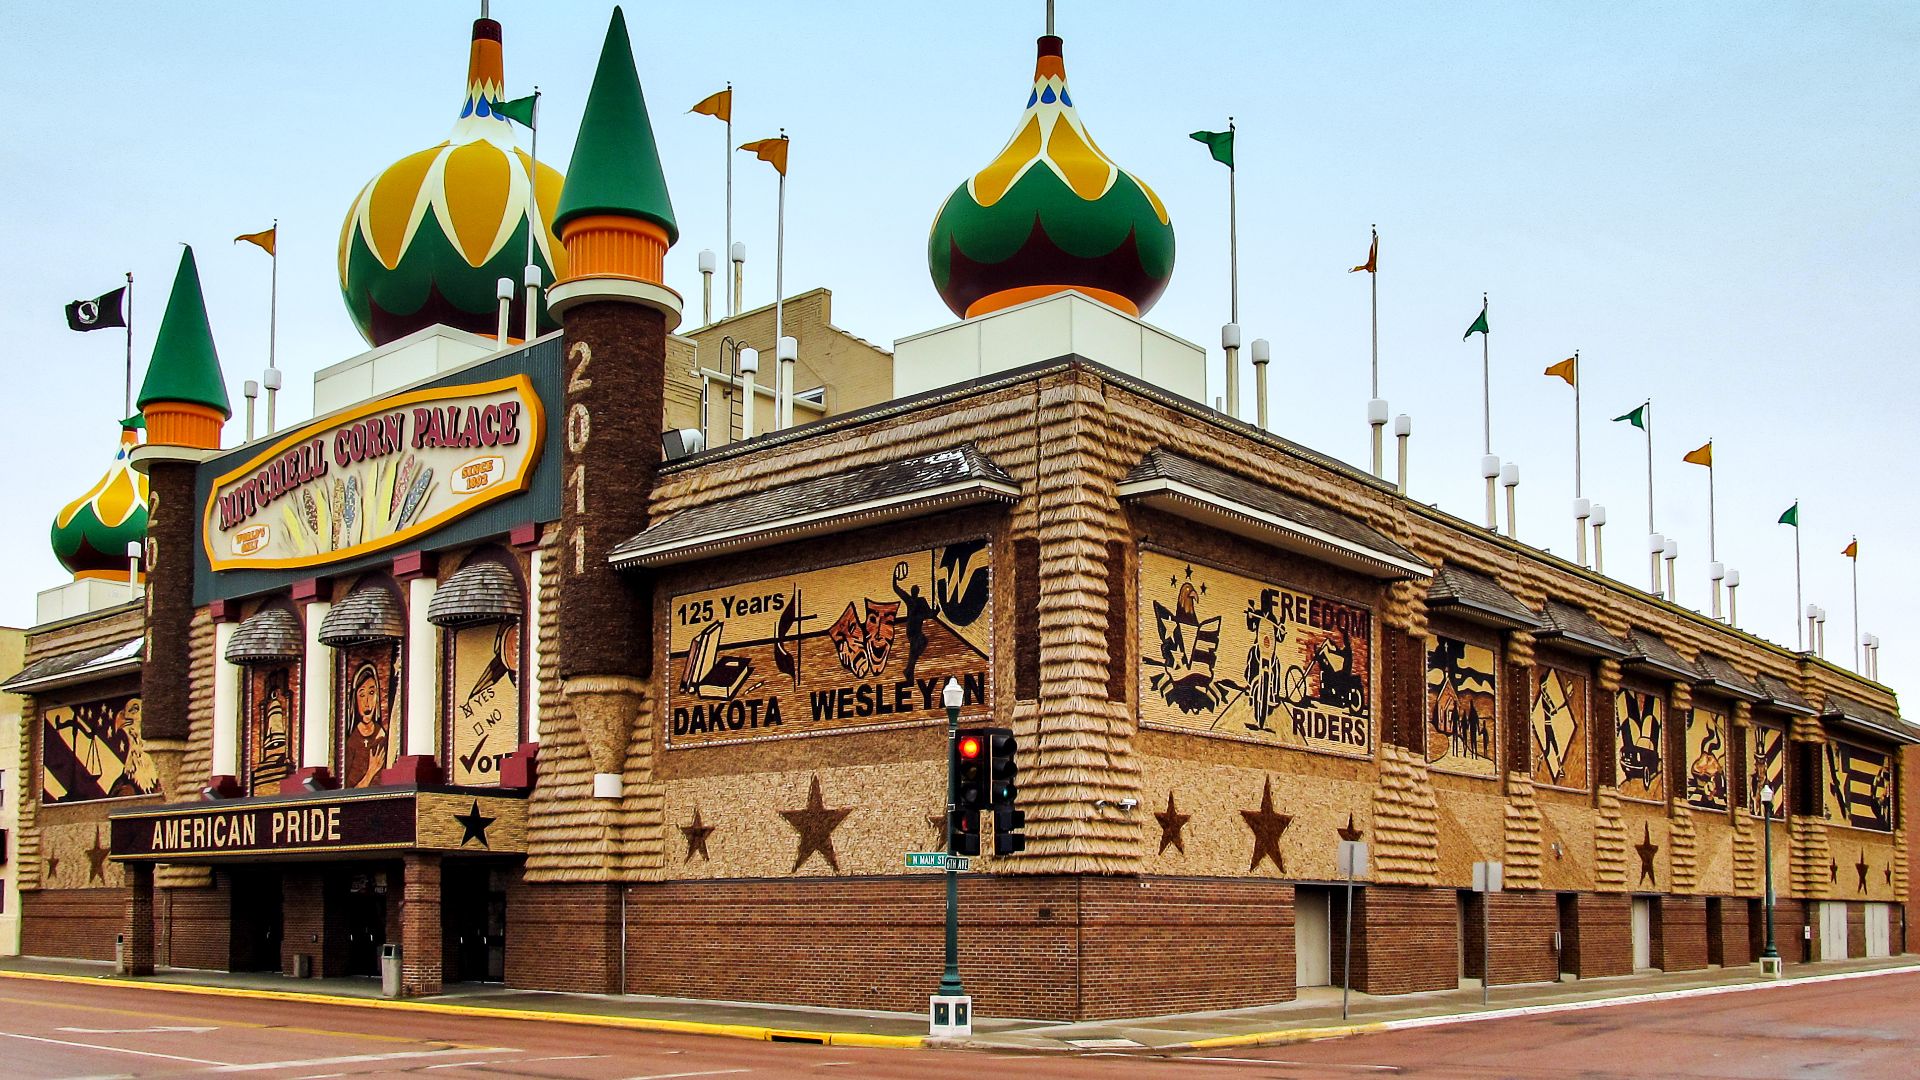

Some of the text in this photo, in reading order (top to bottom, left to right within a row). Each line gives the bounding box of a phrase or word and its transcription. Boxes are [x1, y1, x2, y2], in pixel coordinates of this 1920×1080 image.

[218, 401, 520, 531] MITCHELL CORN PALACE
[461, 459, 494, 479] SINCE
[568, 341, 592, 574] 2011
[677, 593, 786, 626] 125 Years
[1268, 588, 1369, 640] FREEDOM
[473, 687, 496, 708] YES
[673, 671, 986, 736] DAKOTA WESLEYN
[485, 708, 503, 728] NO
[1292, 708, 1366, 747] RIDERS
[459, 734, 513, 775] VOT
[151, 807, 341, 850] AMERICAN PRIDE
[912, 855, 945, 865] N MAIN ST
[957, 859, 968, 870] AVE
